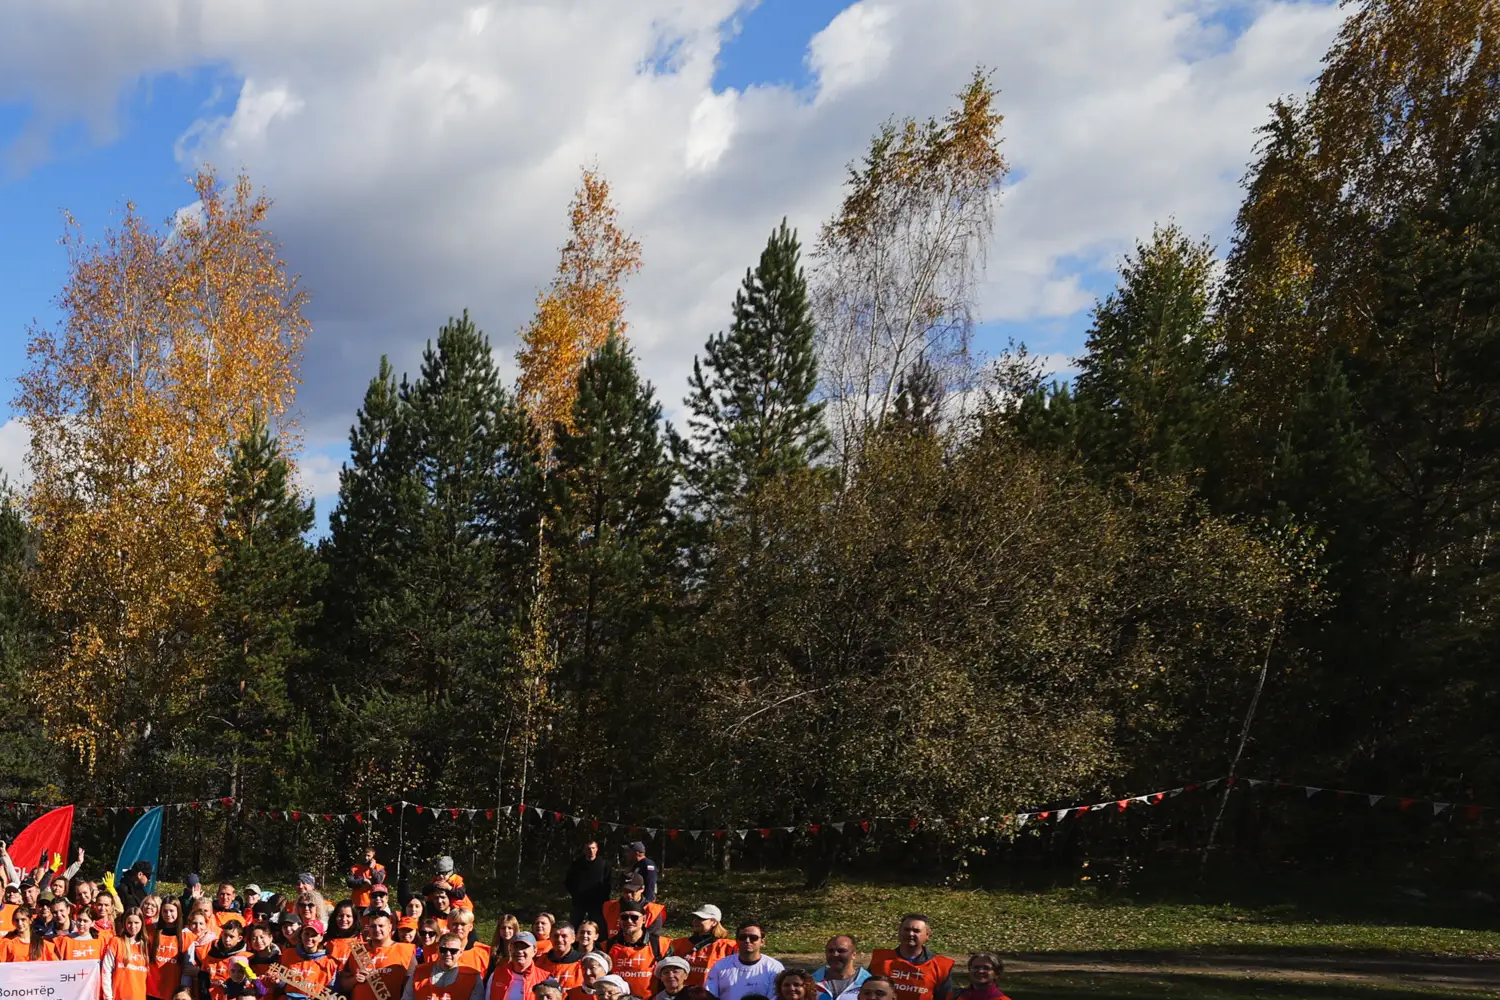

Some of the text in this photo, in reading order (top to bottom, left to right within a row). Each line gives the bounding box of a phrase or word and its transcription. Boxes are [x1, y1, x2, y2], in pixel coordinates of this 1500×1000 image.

[72, 945, 96, 958] ЭН+
[617, 953, 646, 967] ЭН+
[891, 968, 924, 981] ЭН+
[894, 983, 929, 994] ЛОНТЕР
